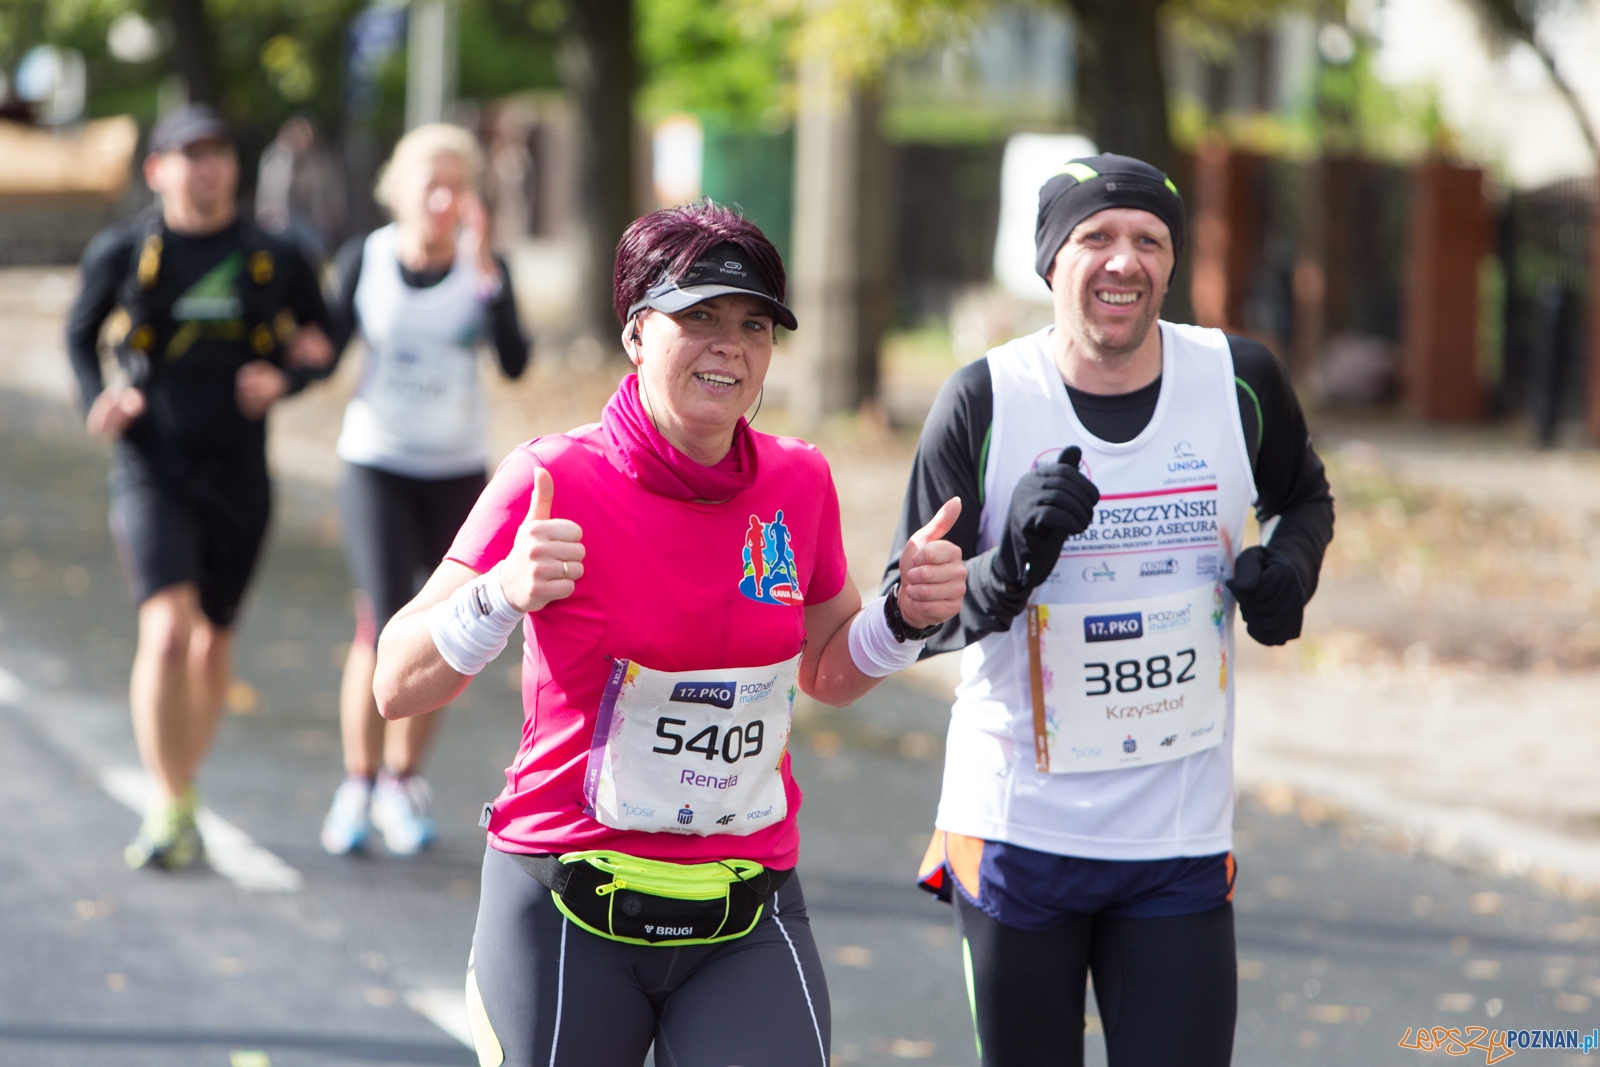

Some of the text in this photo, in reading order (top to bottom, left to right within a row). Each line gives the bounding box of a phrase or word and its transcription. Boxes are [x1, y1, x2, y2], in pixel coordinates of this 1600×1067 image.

[1167, 459, 1208, 472] UNIQA
[1099, 499, 1218, 525] PSZCZYŃSKI
[1102, 525, 1152, 541] CARBO
[1155, 520, 1218, 536] ASECURA
[1109, 618, 1139, 635] PKO
[1084, 647, 1196, 696] 3882
[700, 688, 731, 701] PKO
[739, 689, 771, 704] maraton
[1106, 694, 1185, 720] Krzysztof
[653, 717, 764, 764] 5409
[680, 769, 738, 789] Renata
[715, 814, 736, 825] 4F
[656, 926, 693, 936] BRUGI
